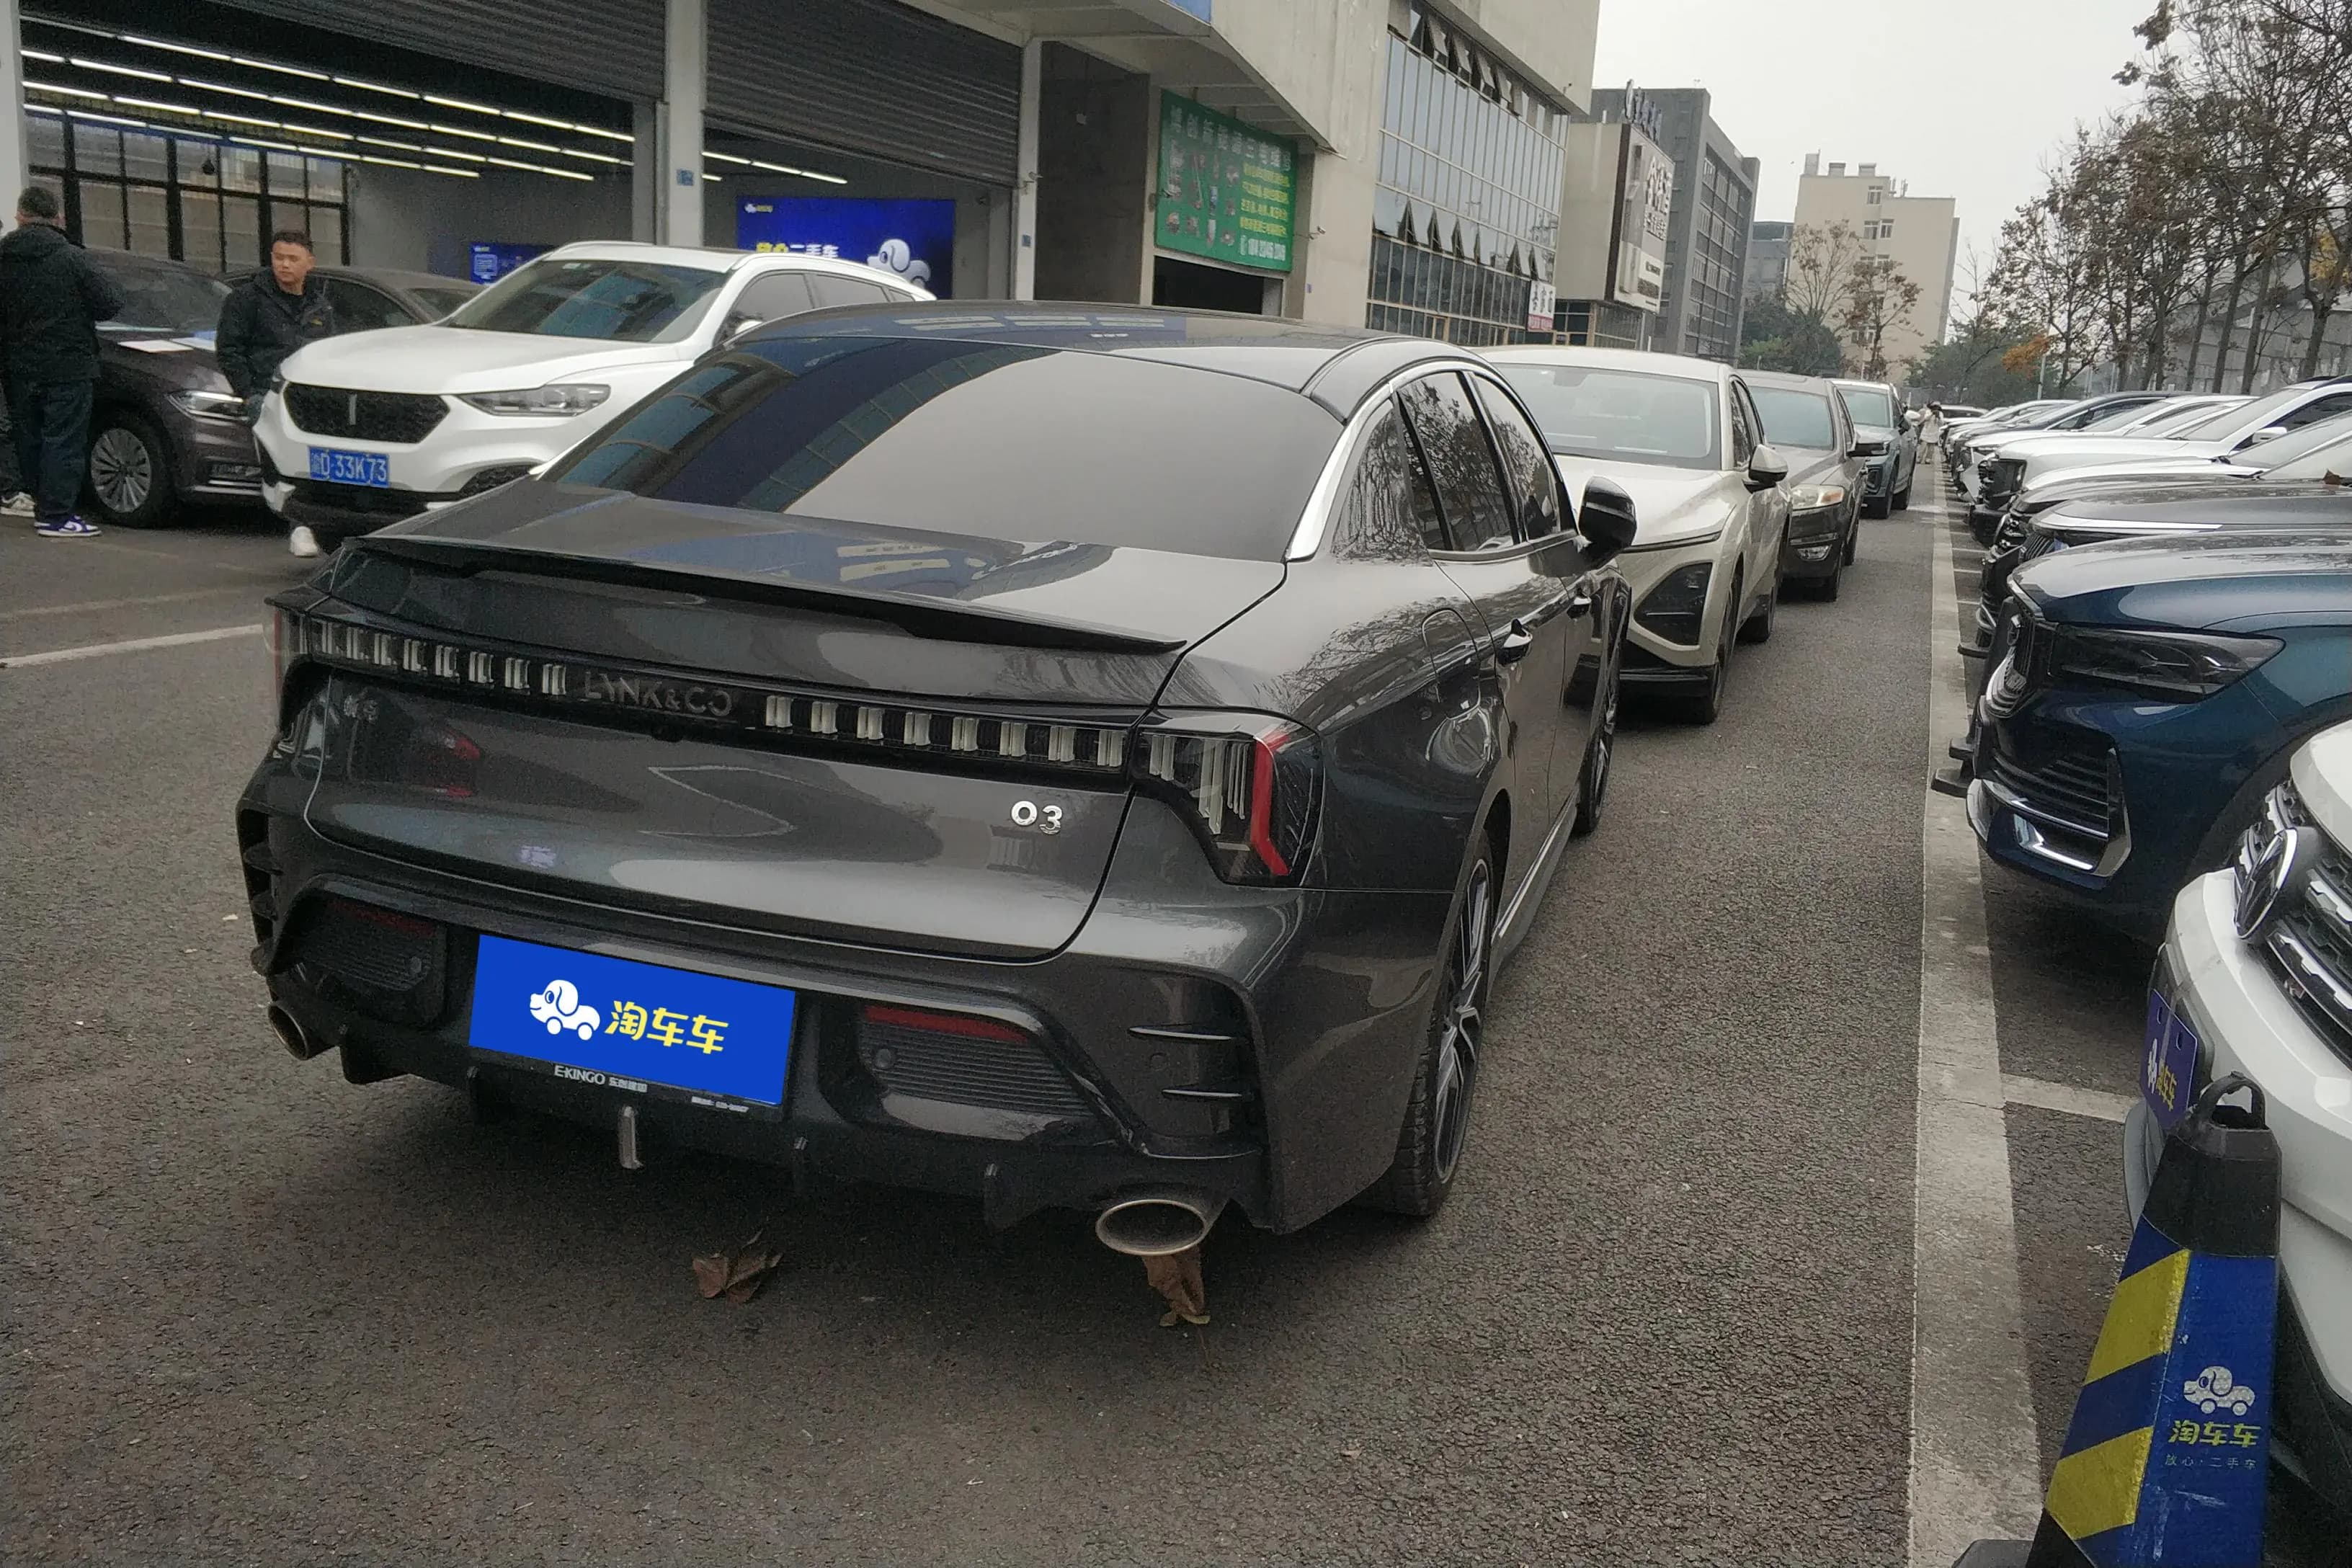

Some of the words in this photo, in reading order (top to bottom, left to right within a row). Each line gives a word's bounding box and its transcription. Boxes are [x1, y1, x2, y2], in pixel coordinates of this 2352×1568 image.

[1011, 801, 1063, 834] 03
[2168, 1419, 2261, 1448] 淘车车
